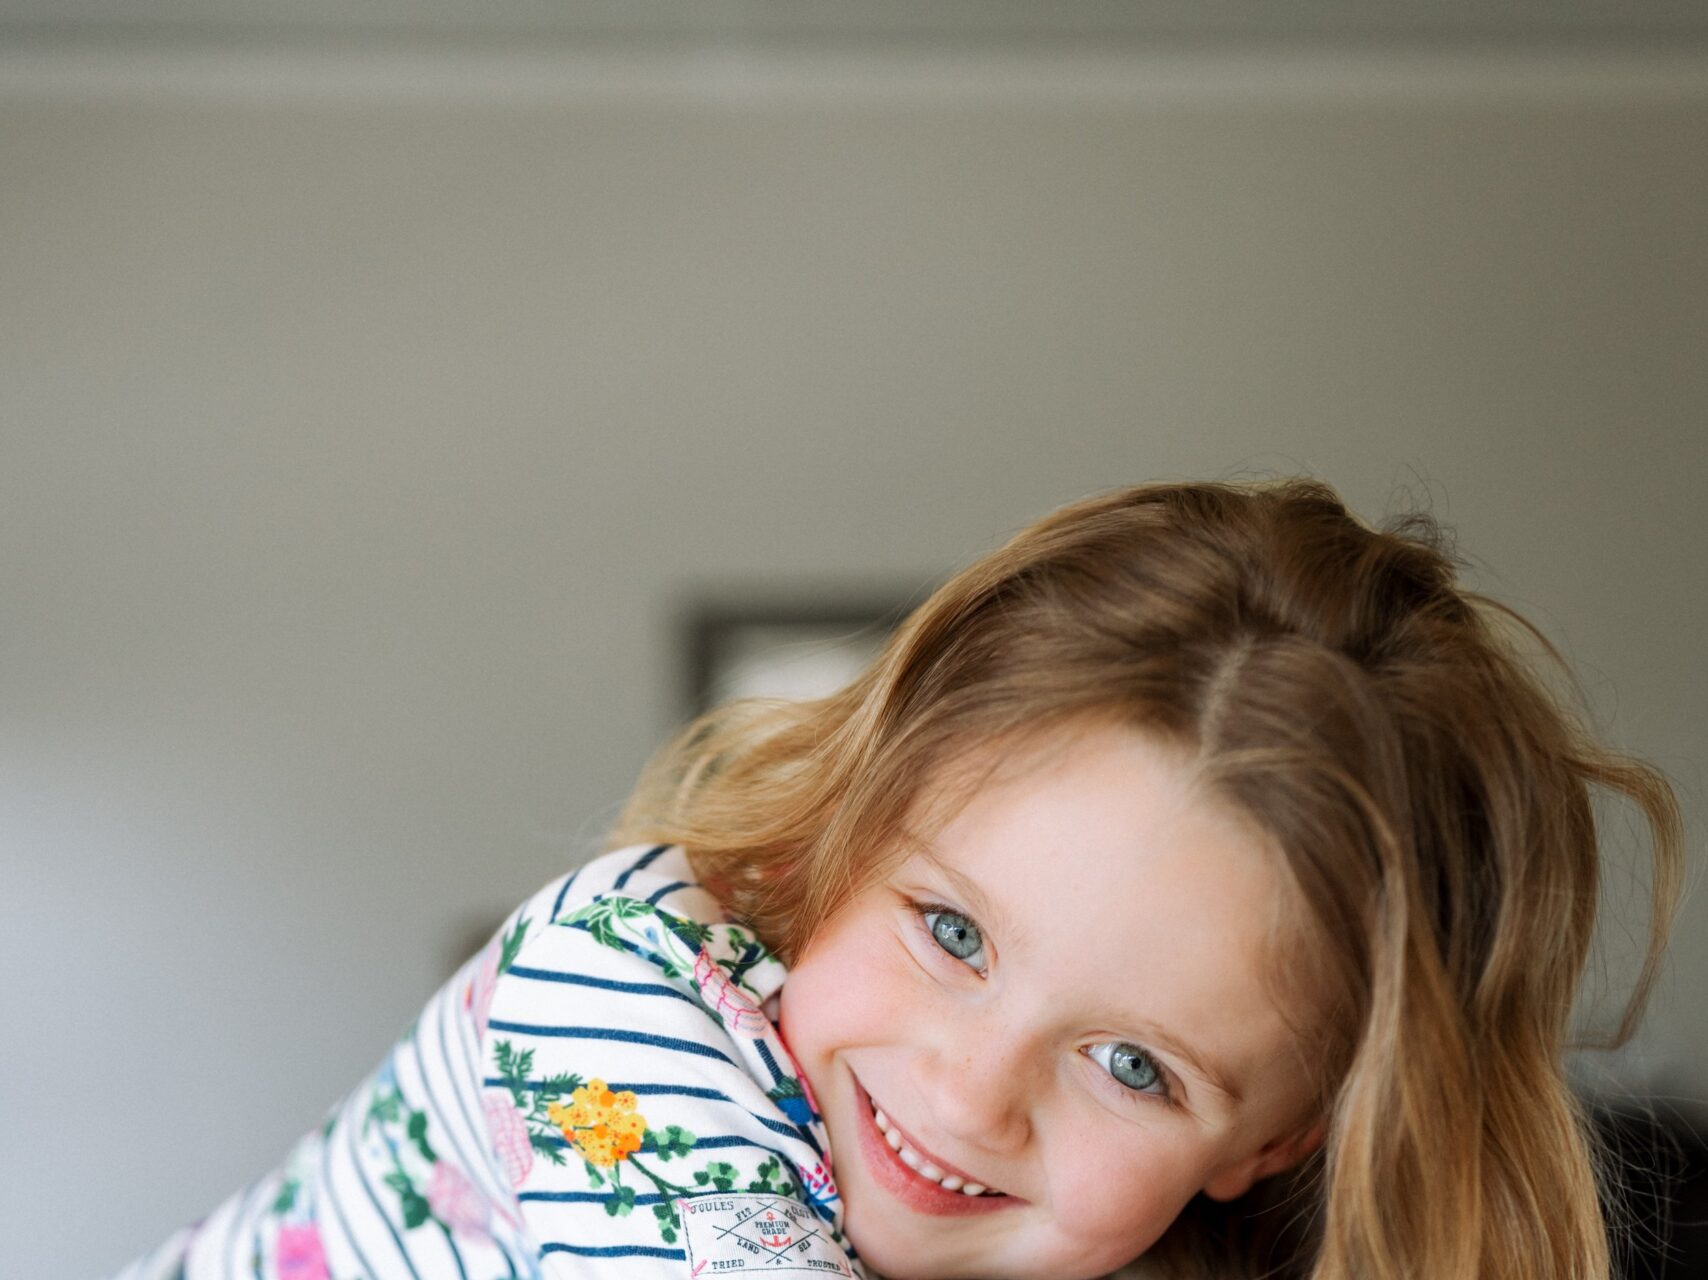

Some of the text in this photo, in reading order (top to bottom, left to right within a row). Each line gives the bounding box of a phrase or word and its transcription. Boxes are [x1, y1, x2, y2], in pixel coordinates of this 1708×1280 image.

[690, 1201, 734, 1214] JOULES
[735, 1207, 752, 1221] FIT
[737, 1238, 760, 1255] LAND
[798, 1240, 811, 1252] SEA
[712, 1259, 745, 1270] TRIED
[807, 1259, 841, 1271] TRUSTED
